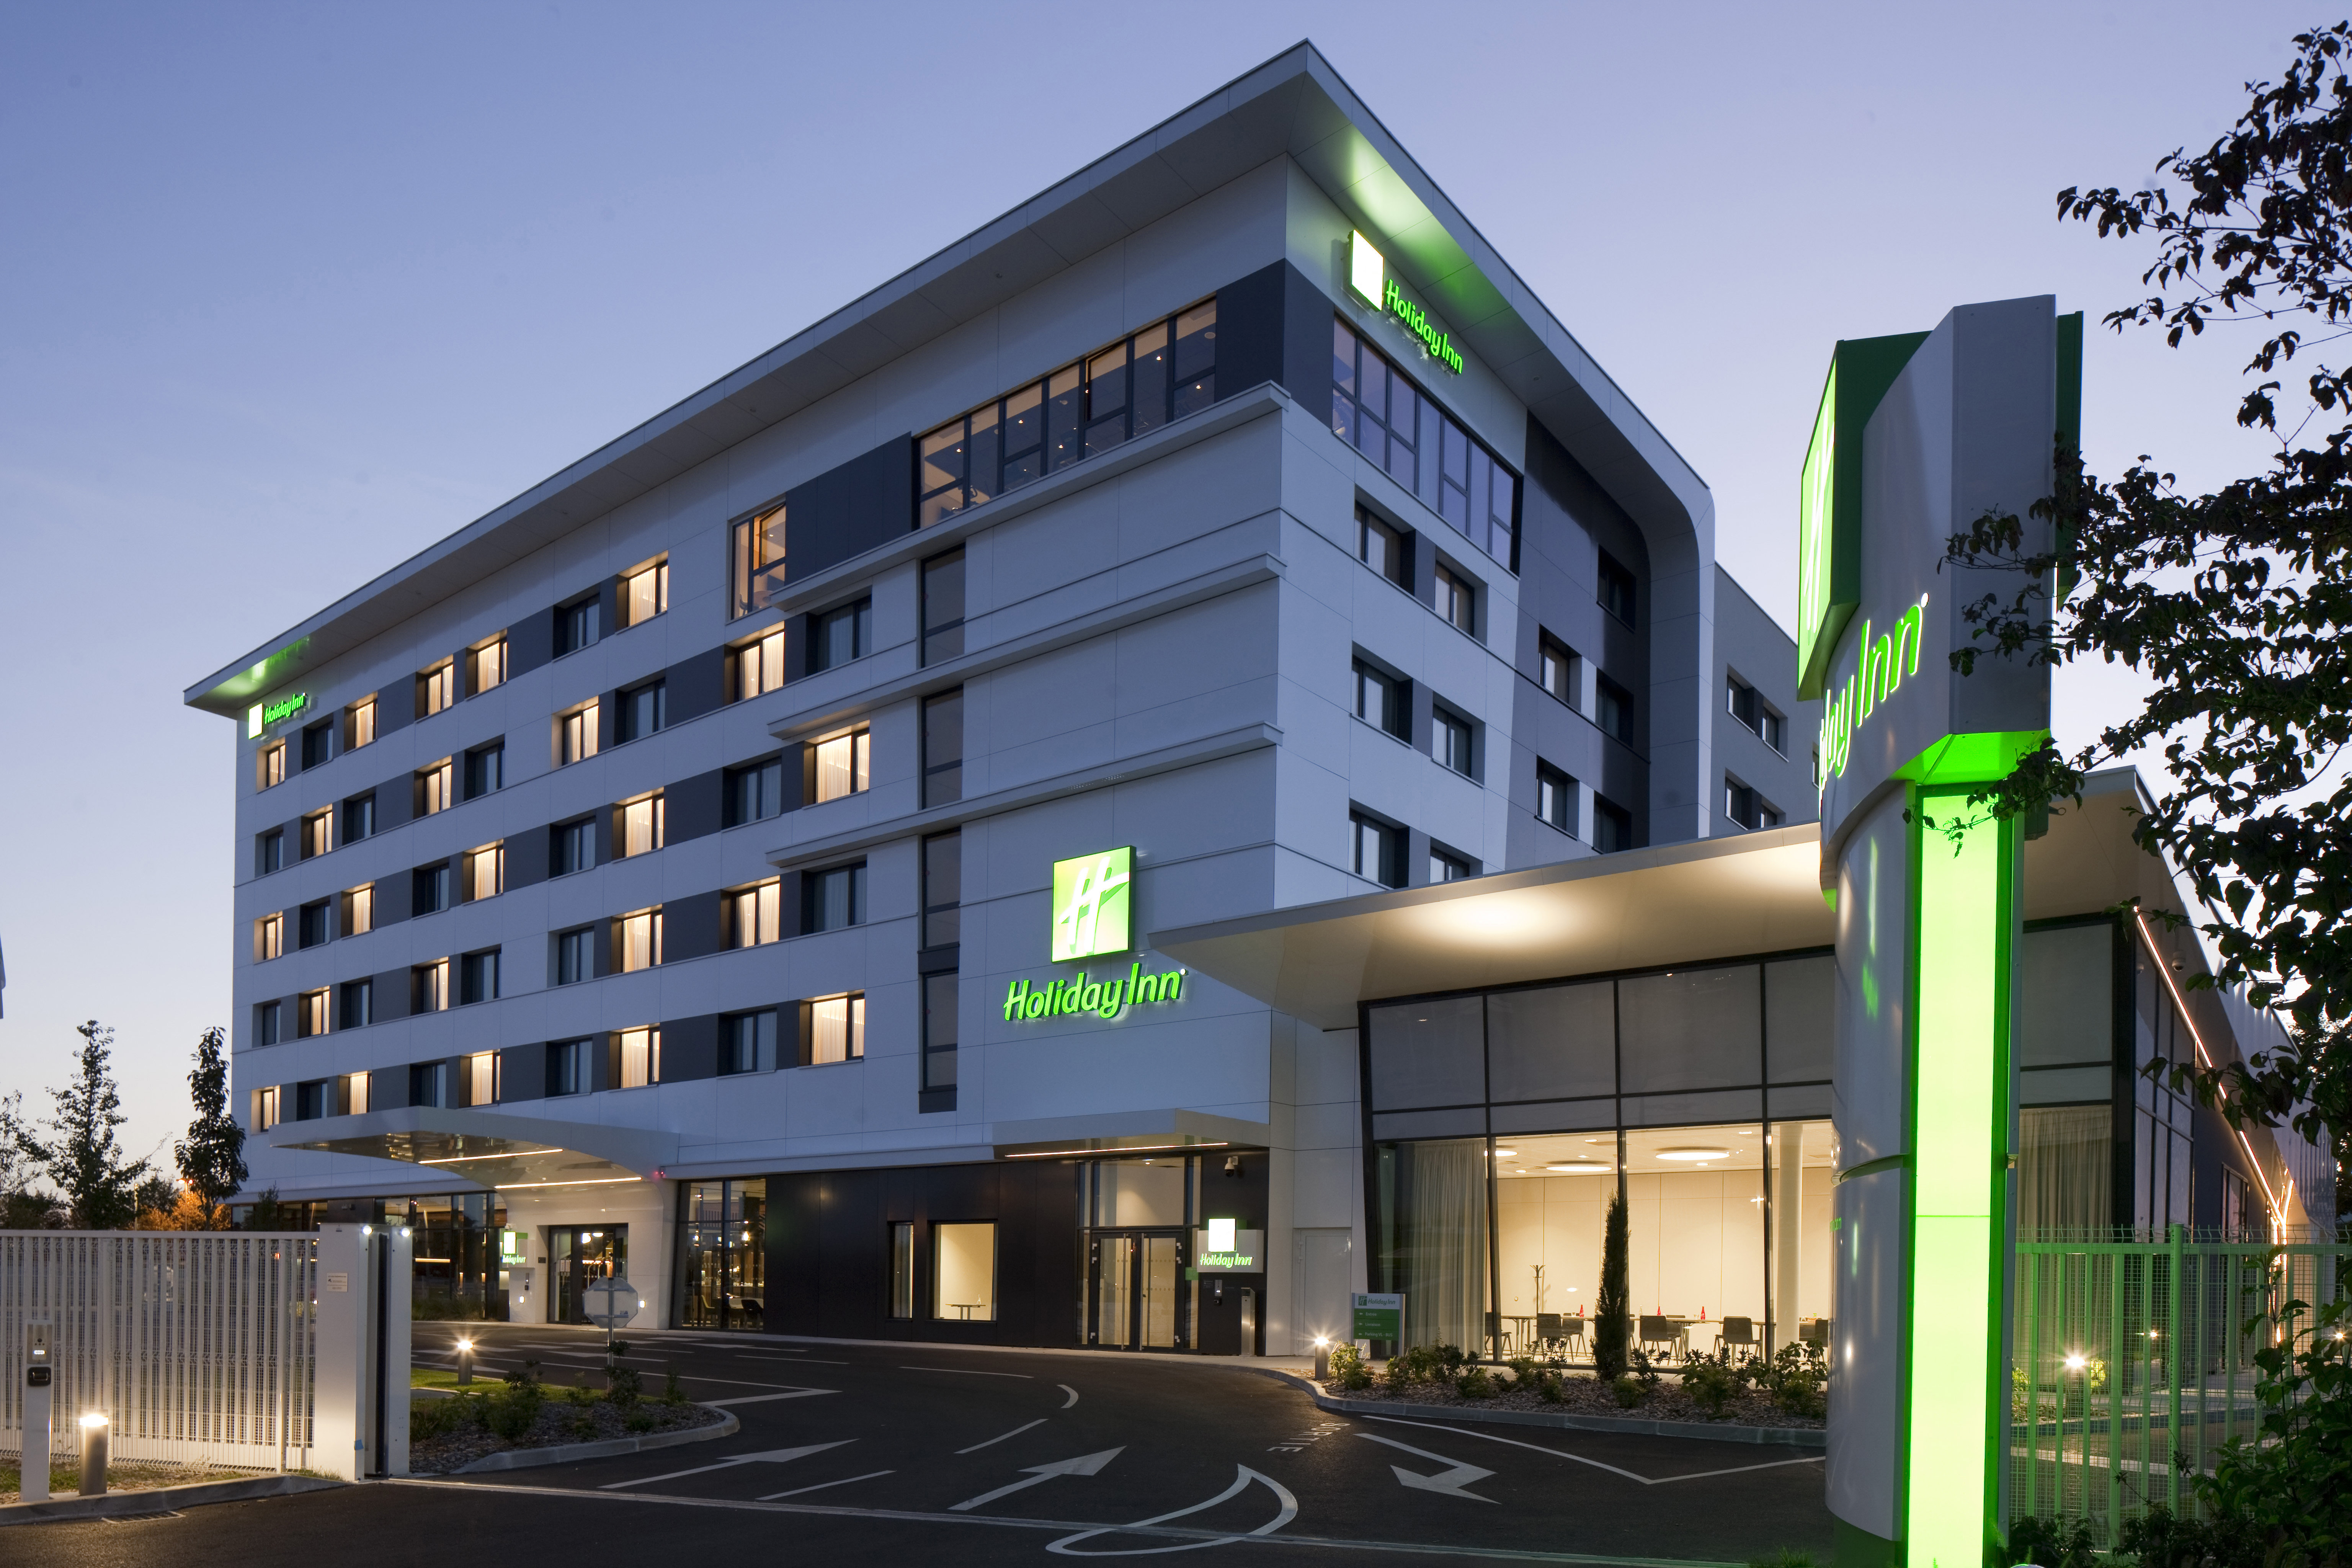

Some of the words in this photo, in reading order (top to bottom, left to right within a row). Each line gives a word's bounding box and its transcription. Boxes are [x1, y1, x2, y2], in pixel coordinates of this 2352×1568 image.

[1386, 279, 1441, 356] Holiday
[1442, 333, 1463, 374] Inn
[1856, 605, 1922, 727] Inn
[265, 700, 291, 724] Holiday
[291, 694, 304, 711] Inn
[1003, 972, 1123, 1021] Holiday
[1127, 962, 1180, 1005] Inn
[1200, 1253, 1234, 1268] Holiday
[1234, 1253, 1253, 1265] Inn
[1266, 1423, 1351, 1452] SORTIE
